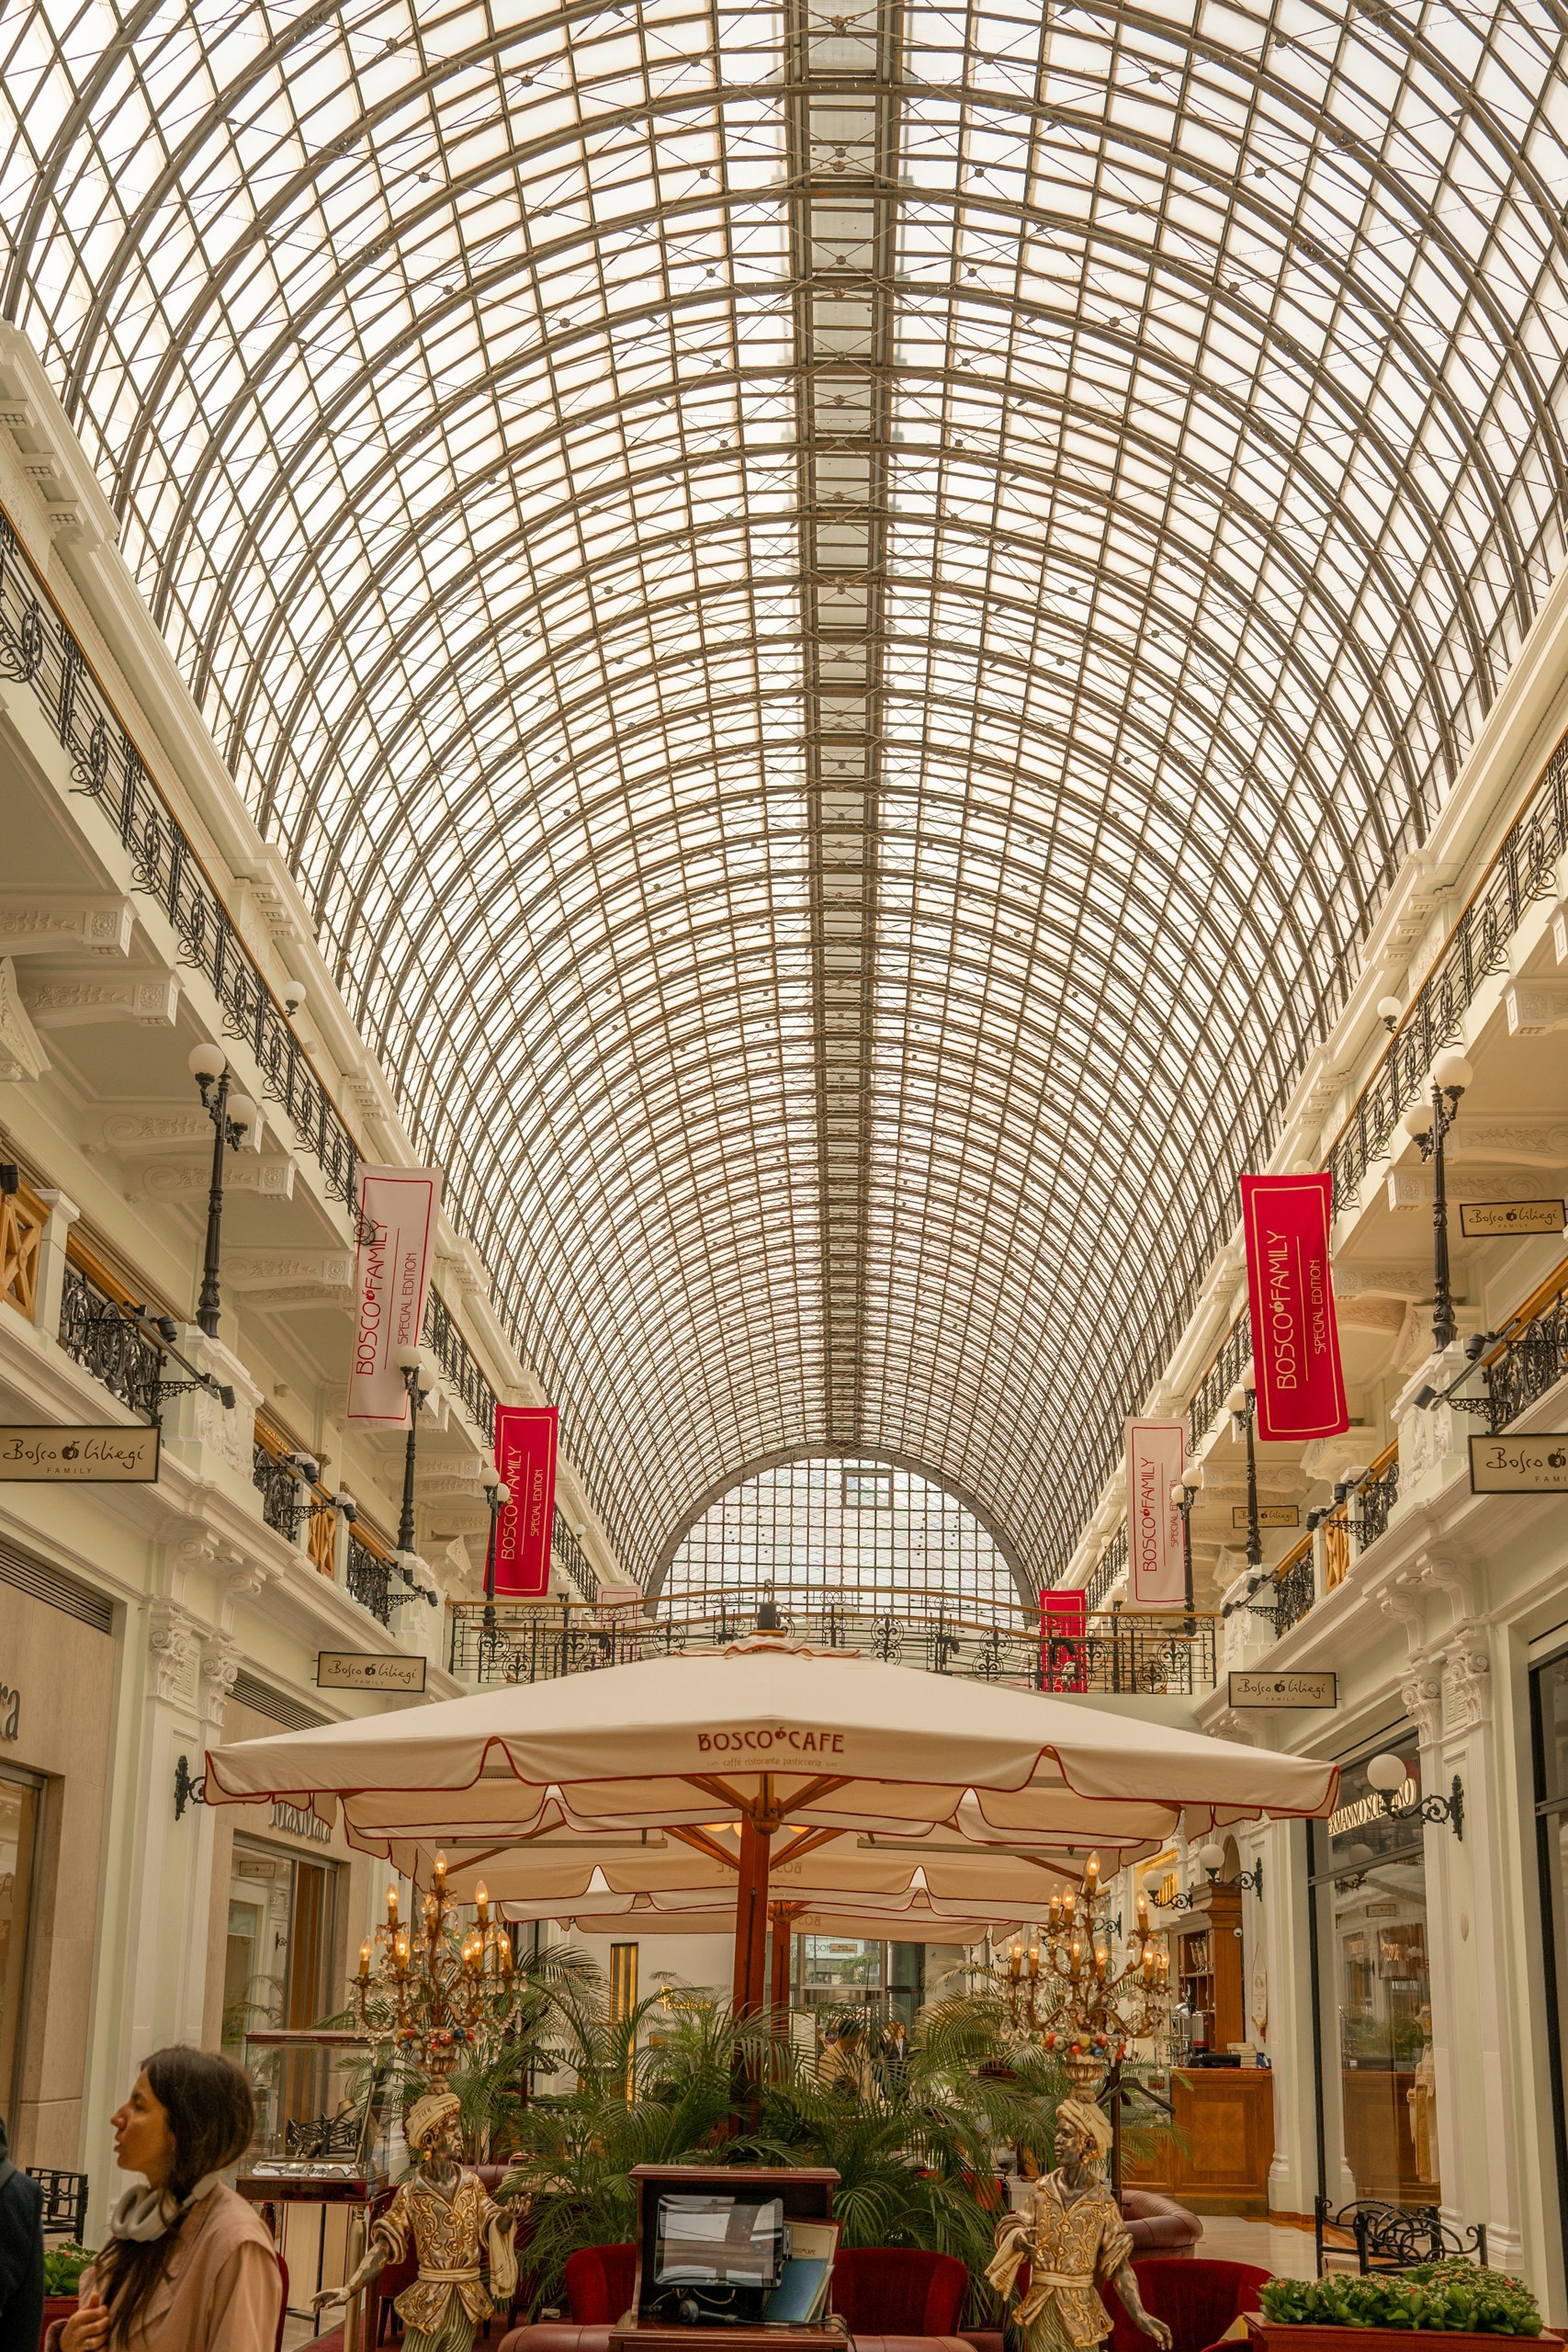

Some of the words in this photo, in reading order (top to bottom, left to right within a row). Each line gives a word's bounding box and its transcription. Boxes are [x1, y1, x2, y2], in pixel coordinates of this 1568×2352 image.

[1469, 1209, 1504, 1227] Bosco
[1518, 1206, 1558, 1226] Ciliegi
[365, 1219, 389, 1290] FAMILY
[401, 1252, 417, 1296] EDITION
[1266, 1229, 1292, 1301] FAMILY
[1309, 1260, 1324, 1305] EDITION
[355, 1301, 381, 1375] BOSCO
[397, 1298, 412, 1345] SPECIAL
[1311, 1306, 1326, 1355] SPECIAL
[1273, 1312, 1298, 1389] BOSCO
[2, 1439, 58, 1465] Bosco
[84, 1438, 146, 1470] Ciliegi
[1485, 1446, 1543, 1475] Bosco
[533, 1469, 544, 1501] EDITION
[1140, 1457, 1156, 1510] FAMILY
[501, 1505, 519, 1561] BOSCO
[530, 1502, 542, 1537] SPECIAL
[1169, 1512, 1179, 1548] SPECIAL
[1141, 1517, 1157, 1572] BOSCO
[327, 1659, 362, 1679] Bosco
[378, 1662, 418, 1684] Ciliegi
[1236, 1678, 1272, 1697] Bosco
[1288, 1679, 1326, 1700] Ciliegi
[697, 1730, 773, 1752] BOSCO
[788, 1731, 844, 1754] CAFE
[744, 1756, 780, 1767] ristorante
[783, 1757, 822, 1769] pasticceria
